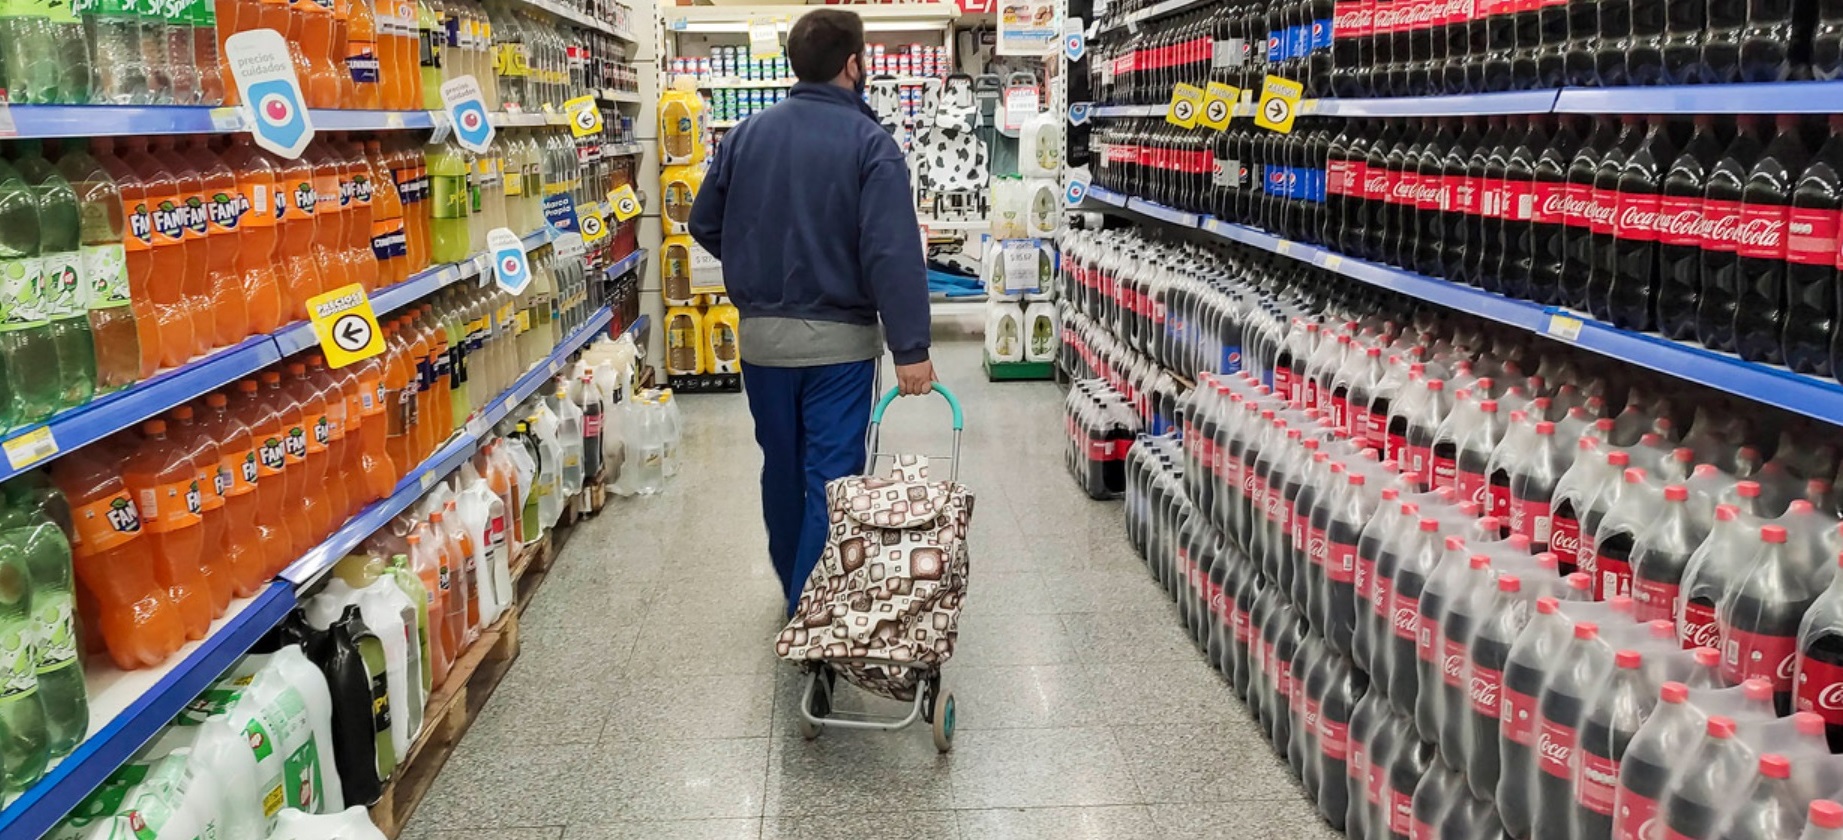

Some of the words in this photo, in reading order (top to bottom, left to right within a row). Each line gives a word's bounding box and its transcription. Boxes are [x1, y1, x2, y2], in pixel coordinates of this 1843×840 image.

[238, 53, 274, 68] precios
[241, 62, 286, 78] cuidados
[445, 83, 469, 96] precios
[447, 88, 476, 102] cuidados
[544, 199, 569, 210] Marca
[545, 206, 571, 218] Propia
[107, 499, 139, 531] FAN
